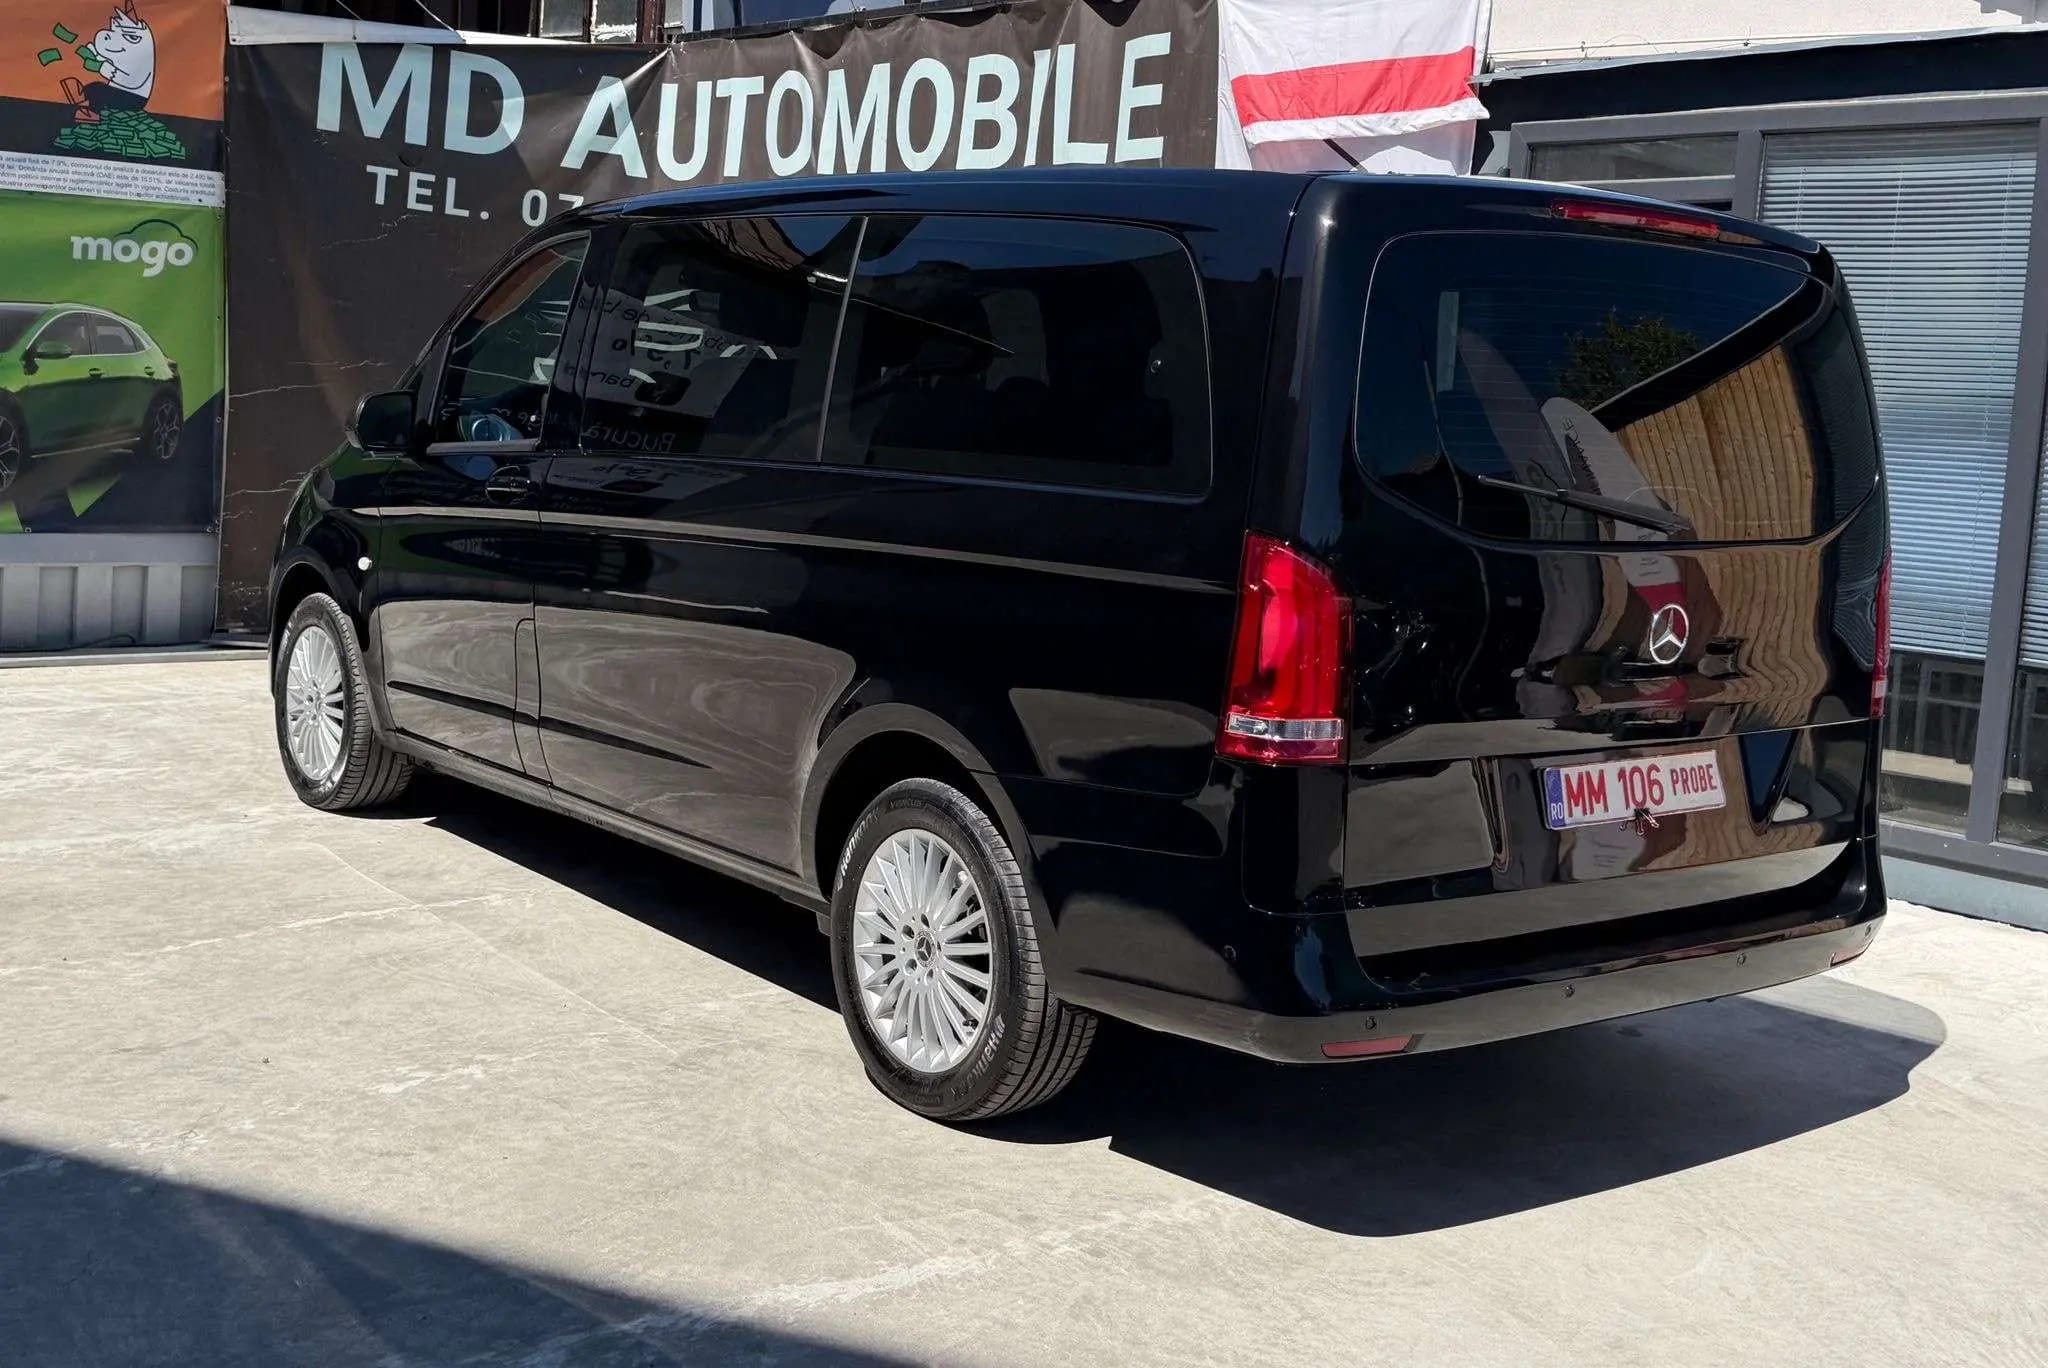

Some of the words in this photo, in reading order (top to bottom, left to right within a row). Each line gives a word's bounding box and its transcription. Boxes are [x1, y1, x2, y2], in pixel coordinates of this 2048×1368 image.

[316, 42, 525, 155] MD
[560, 32, 1172, 181] AUTOMOBILE
[366, 164, 490, 220] TEL.
[71, 235, 193, 277] mogo
[1551, 802, 1564, 820] RO
[1564, 769, 1609, 818] MM
[1617, 764, 1665, 810] 106
[1670, 763, 1718, 796] PROBE
